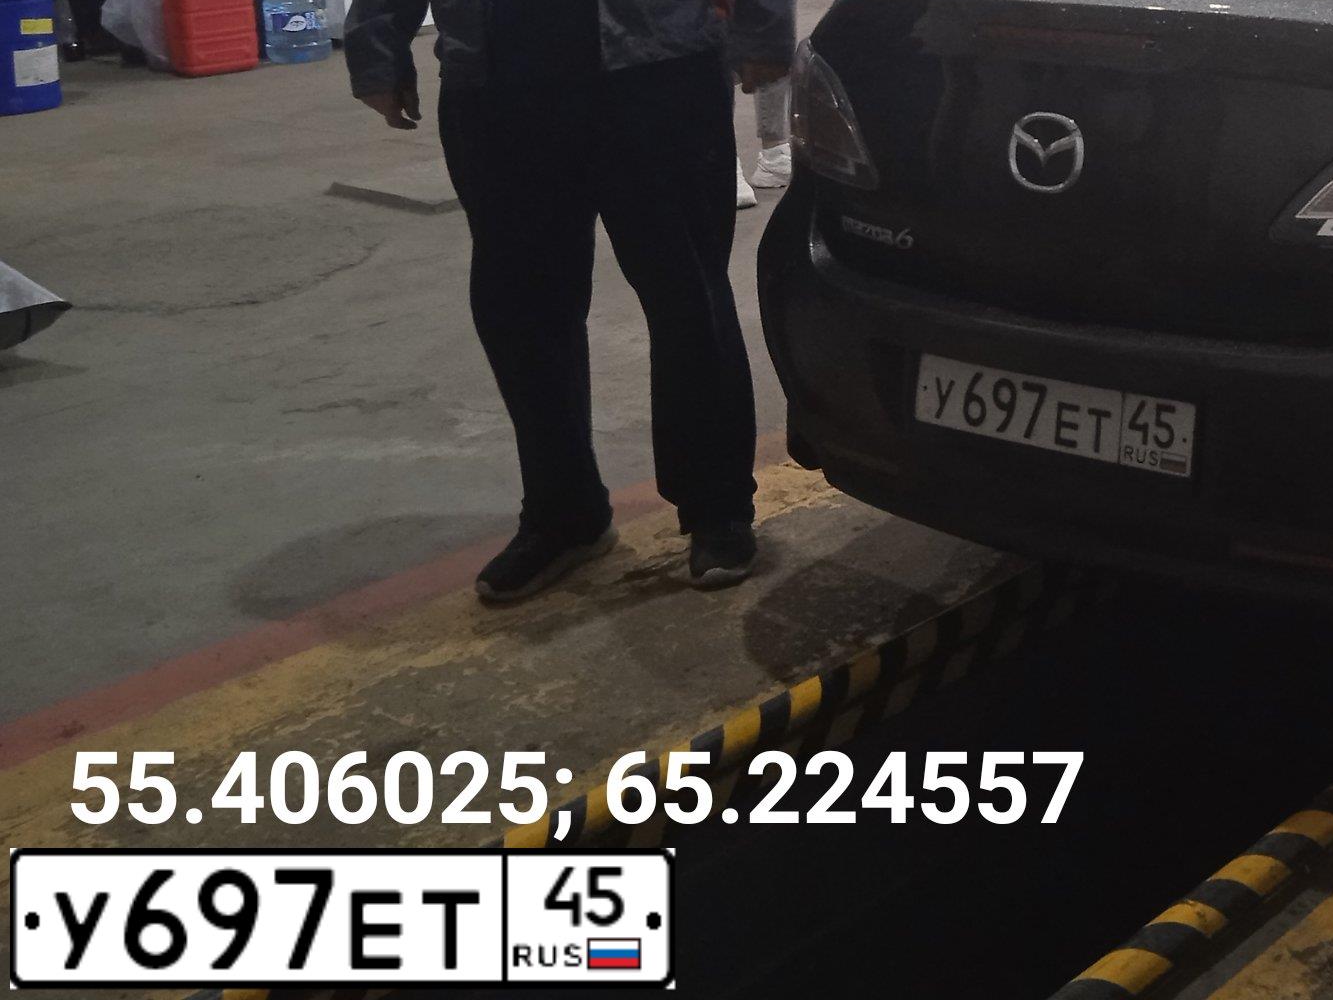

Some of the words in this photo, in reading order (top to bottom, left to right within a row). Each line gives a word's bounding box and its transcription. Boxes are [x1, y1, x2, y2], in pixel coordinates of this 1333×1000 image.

[934, 371, 1112, 453] У697ЕТ
[1128, 400, 1176, 449] 45
[1123, 445, 1159, 466] RUS
